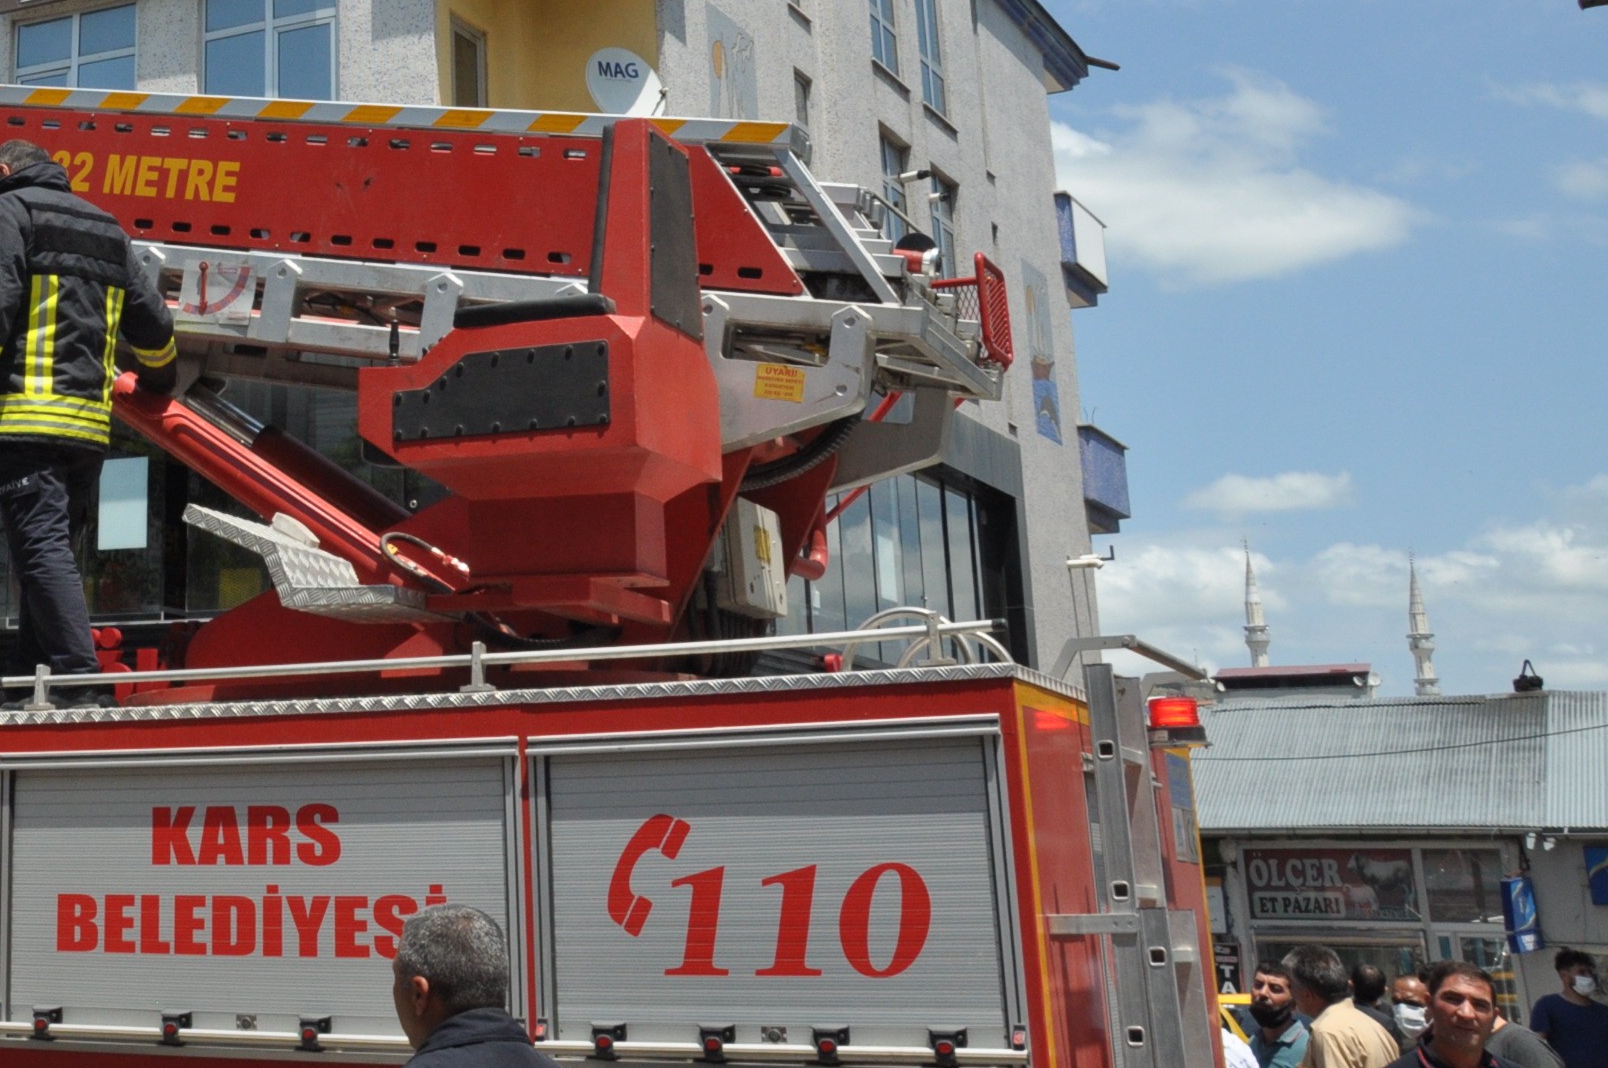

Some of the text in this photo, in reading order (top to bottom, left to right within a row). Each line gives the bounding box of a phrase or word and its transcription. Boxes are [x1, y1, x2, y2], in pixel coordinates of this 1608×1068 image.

[597, 60, 639, 79] MAG
[103, 154, 241, 203] METRE
[151, 803, 341, 866] KARS
[1249, 851, 1343, 894] ÖLÇER
[56, 883, 448, 960] BELEDİYES
[664, 862, 932, 979] 110
[1259, 895, 1341, 915] ET PAZARI
